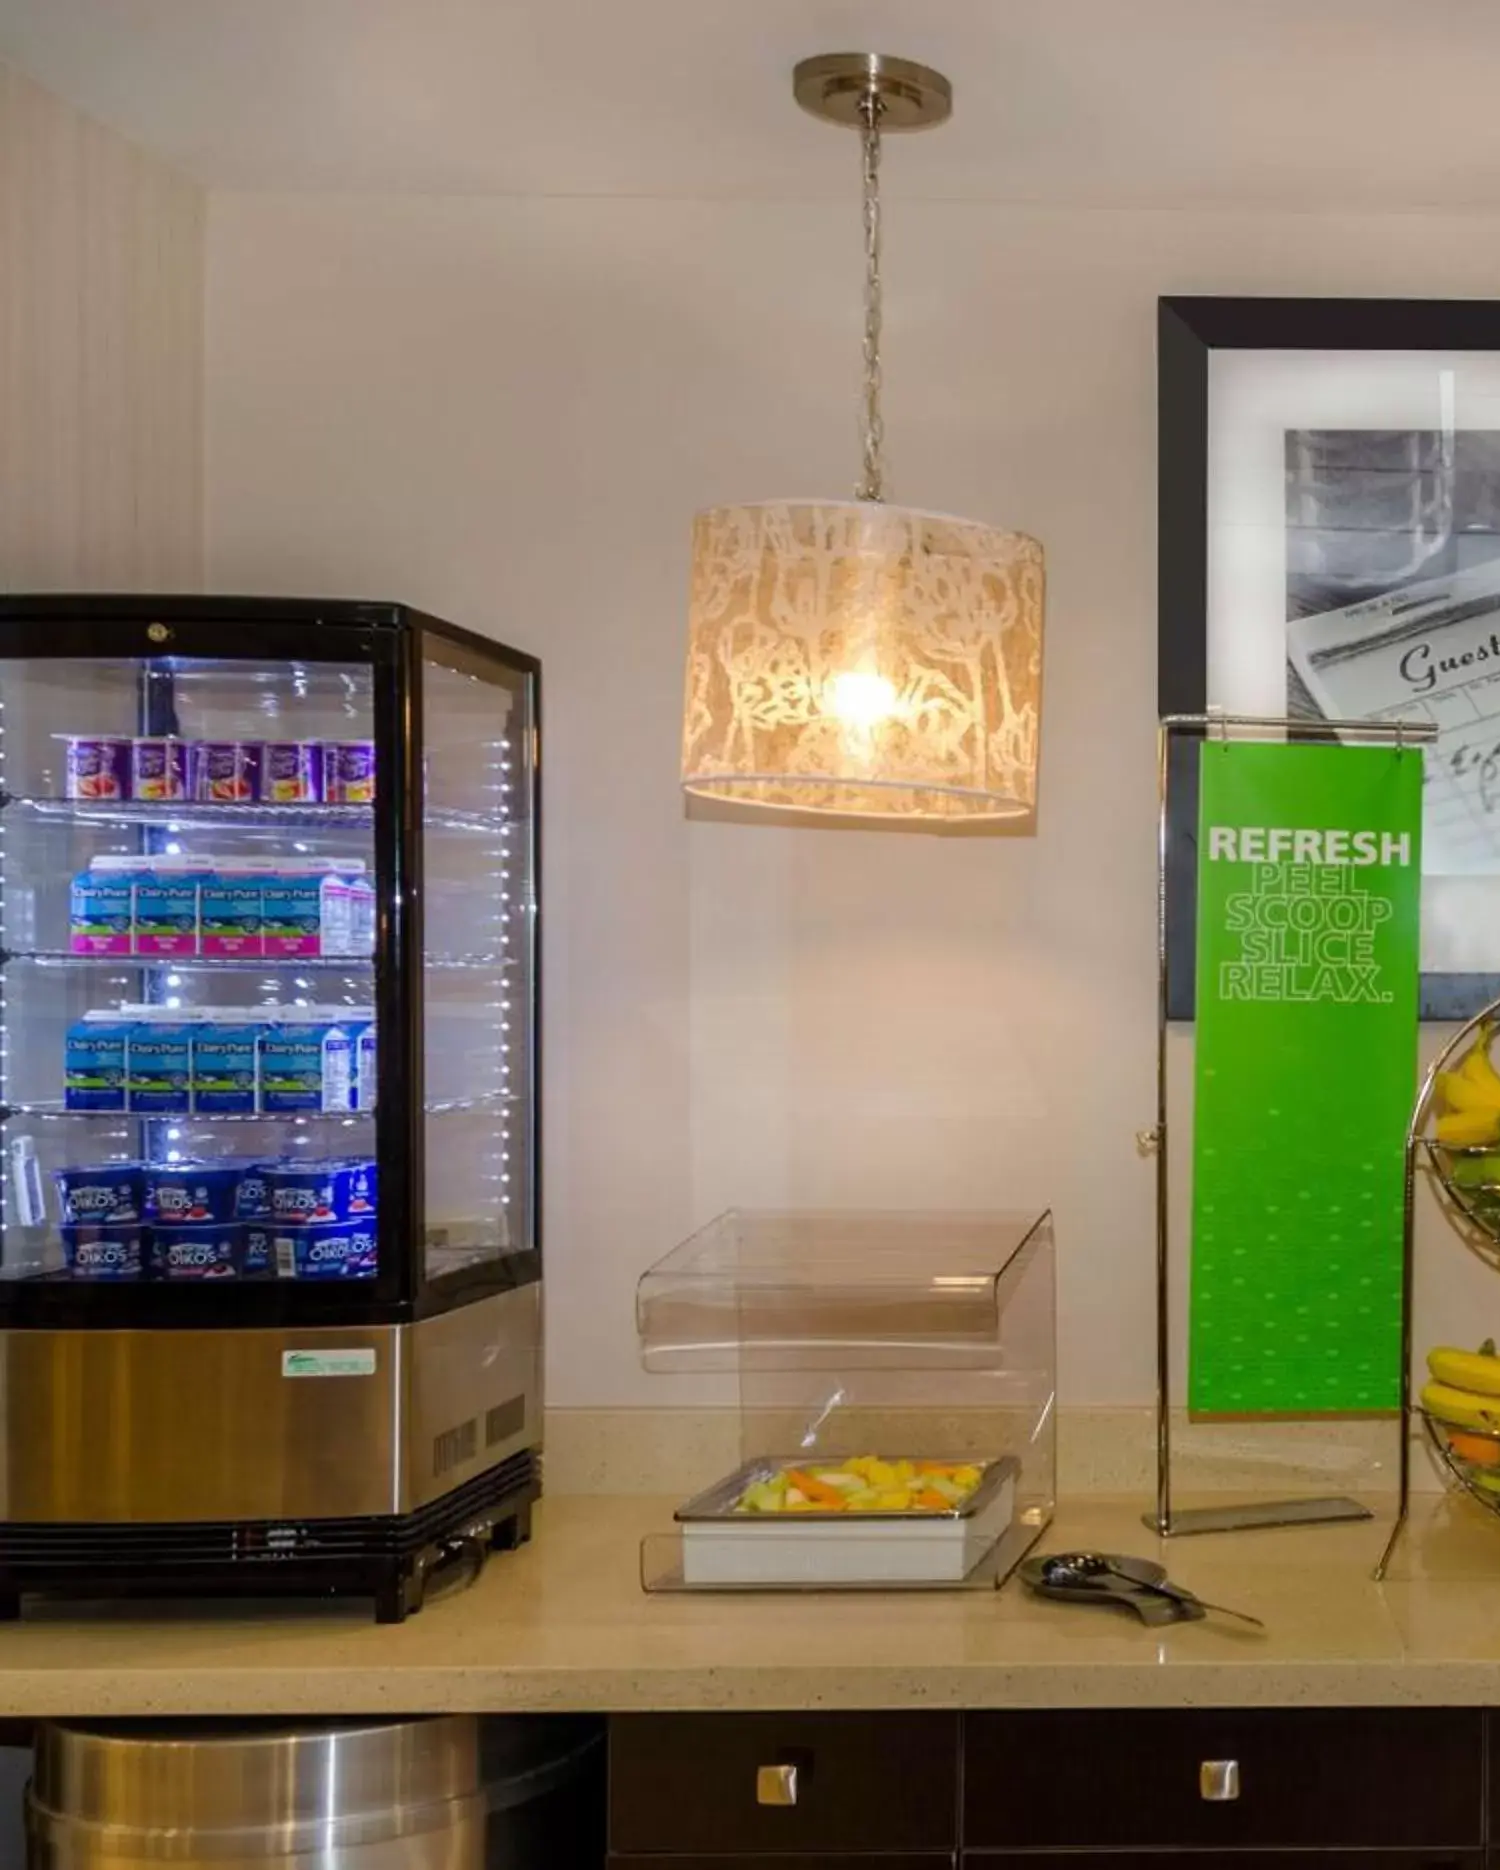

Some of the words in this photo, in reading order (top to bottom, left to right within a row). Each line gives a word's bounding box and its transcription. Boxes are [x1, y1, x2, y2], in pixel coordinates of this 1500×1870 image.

[1208, 826, 1412, 867] REFRESH
[1252, 861, 1369, 898] PEEL
[1225, 892, 1394, 934] SCOOP
[1241, 928, 1377, 967] SLICE
[1219, 961, 1394, 1003] RELAX.
